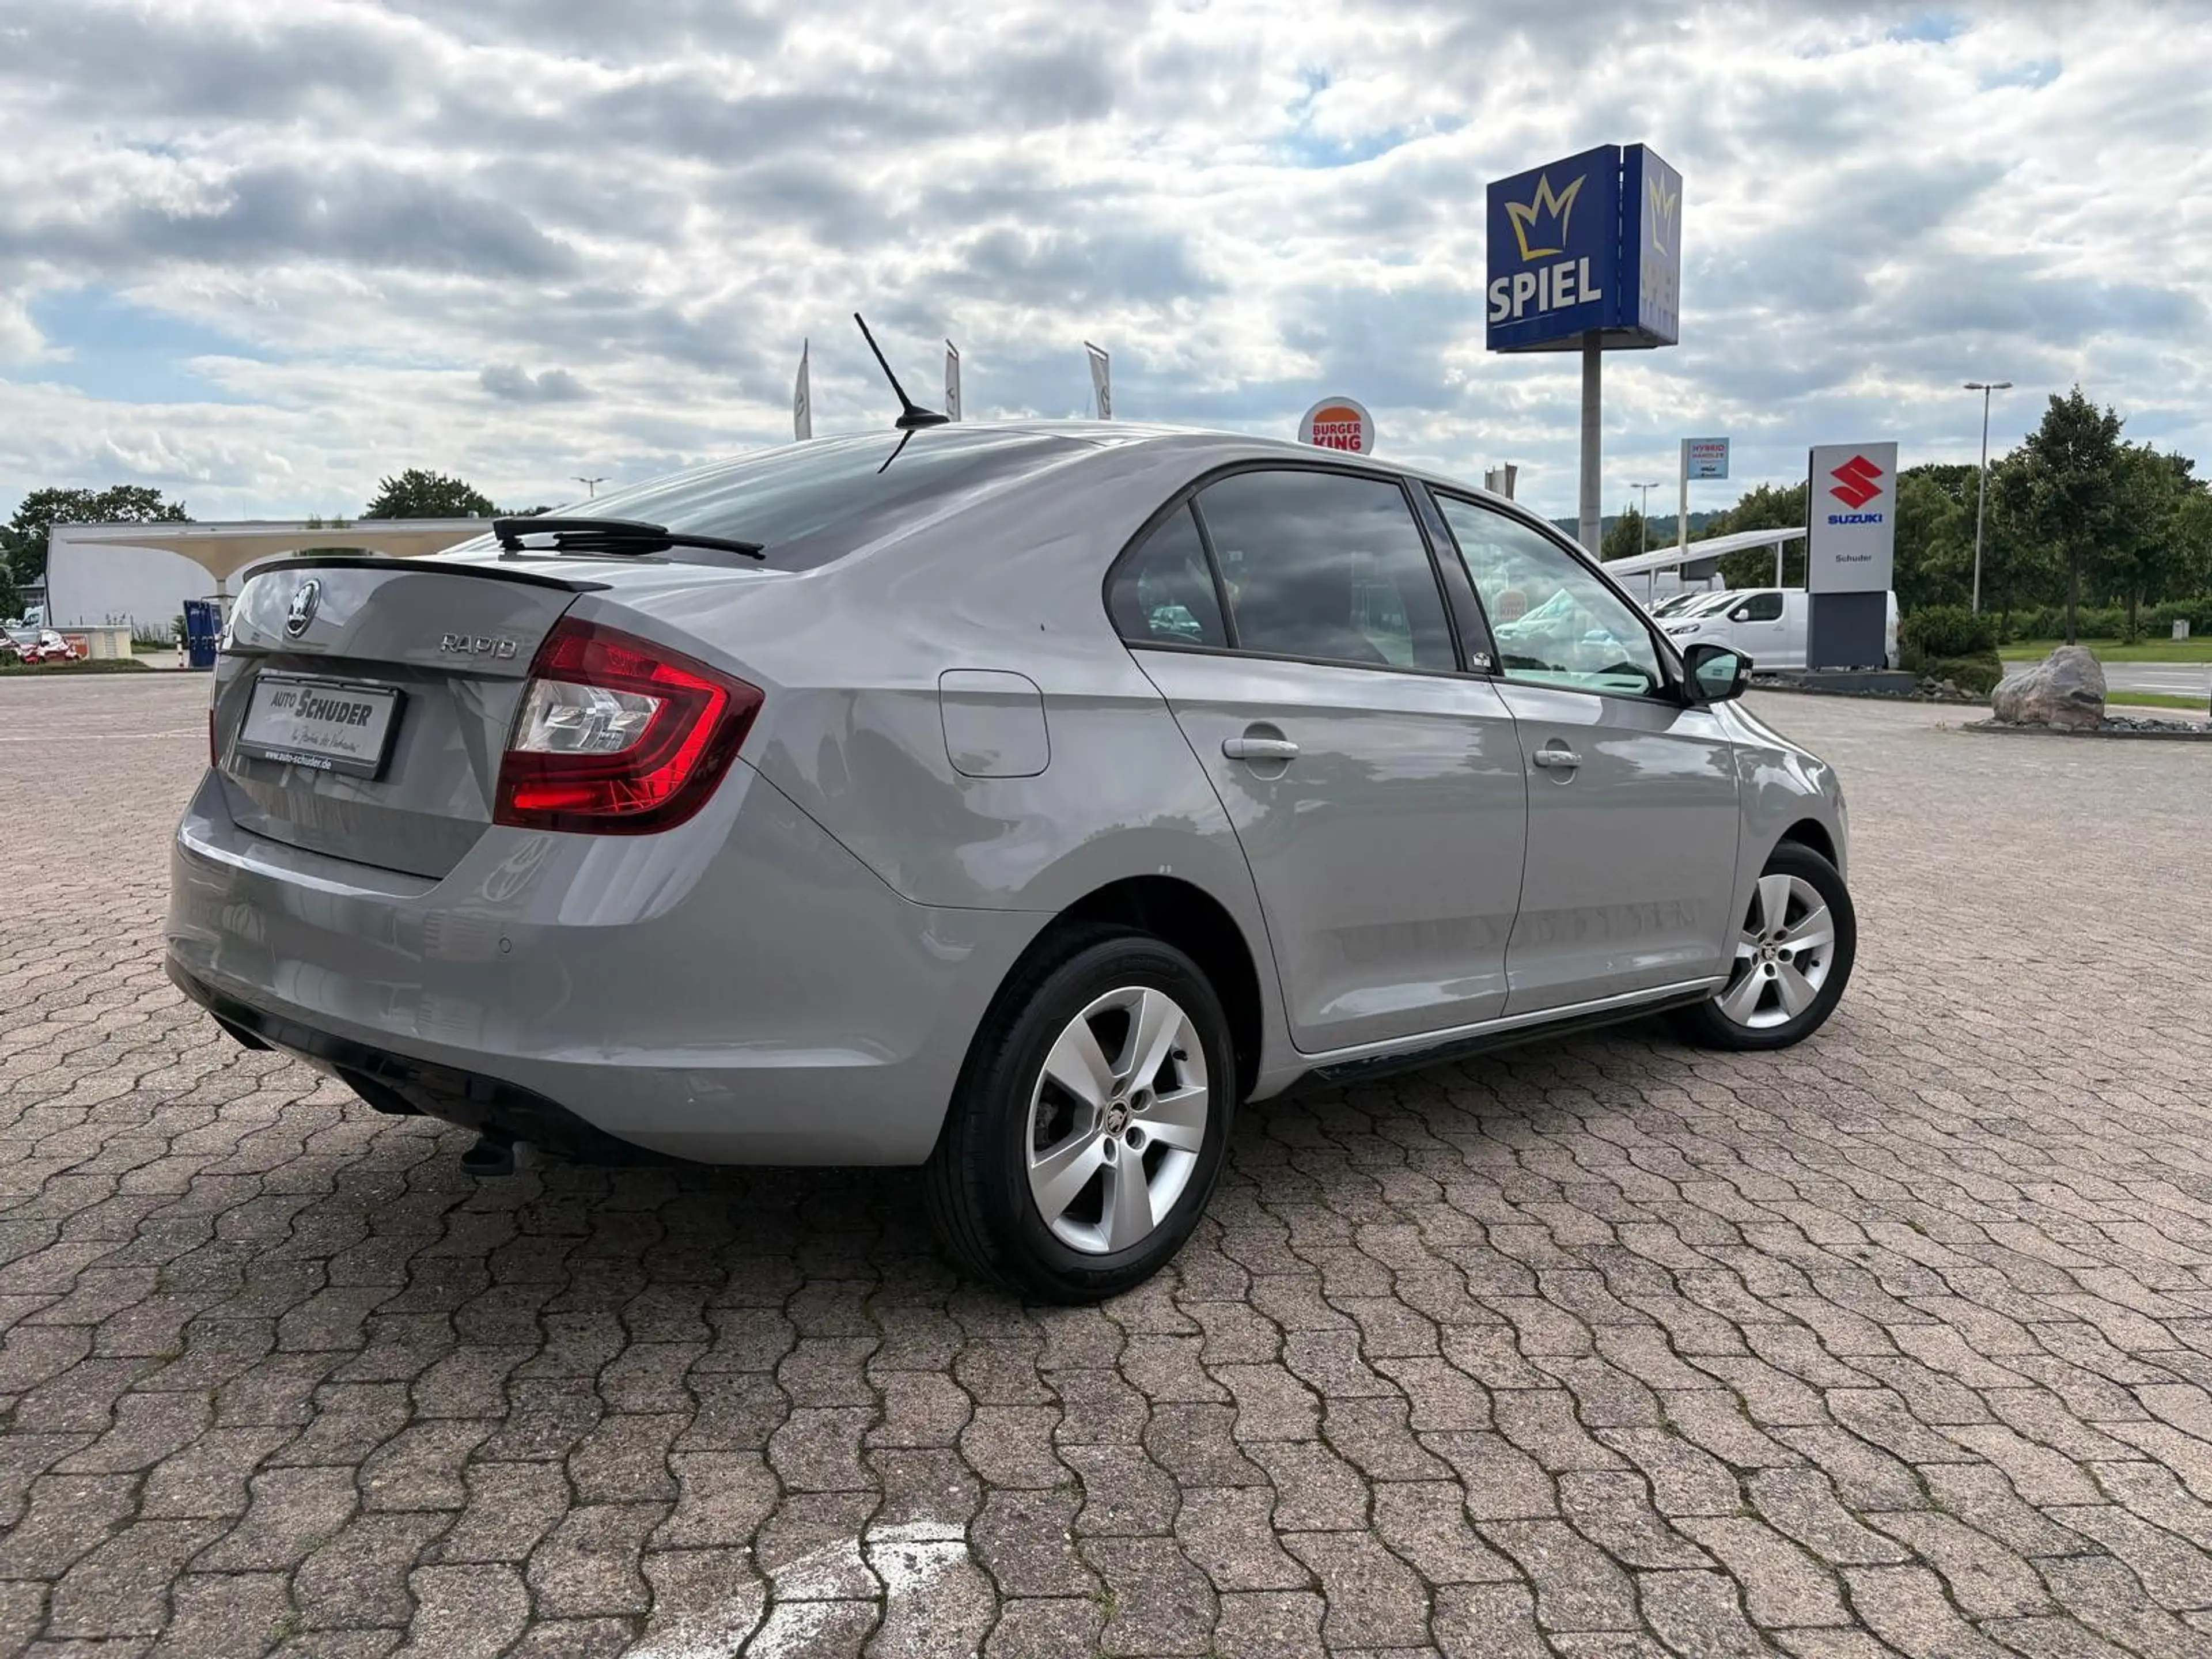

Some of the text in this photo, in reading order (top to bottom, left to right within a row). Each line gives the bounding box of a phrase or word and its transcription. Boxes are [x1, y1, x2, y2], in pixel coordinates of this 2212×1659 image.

[1489, 257, 1602, 323] SPIEL
[1313, 423, 1361, 435] BURGER
[1313, 435, 1361, 450] KING
[1692, 444, 1725, 452] HYBRID
[1828, 513, 1882, 525] SUZUKI
[1835, 554, 1872, 563] Schuder
[440, 632, 517, 658] RAPID
[271, 691, 297, 709] AUTO
[265, 750, 332, 770] www.auto-schuder.de
